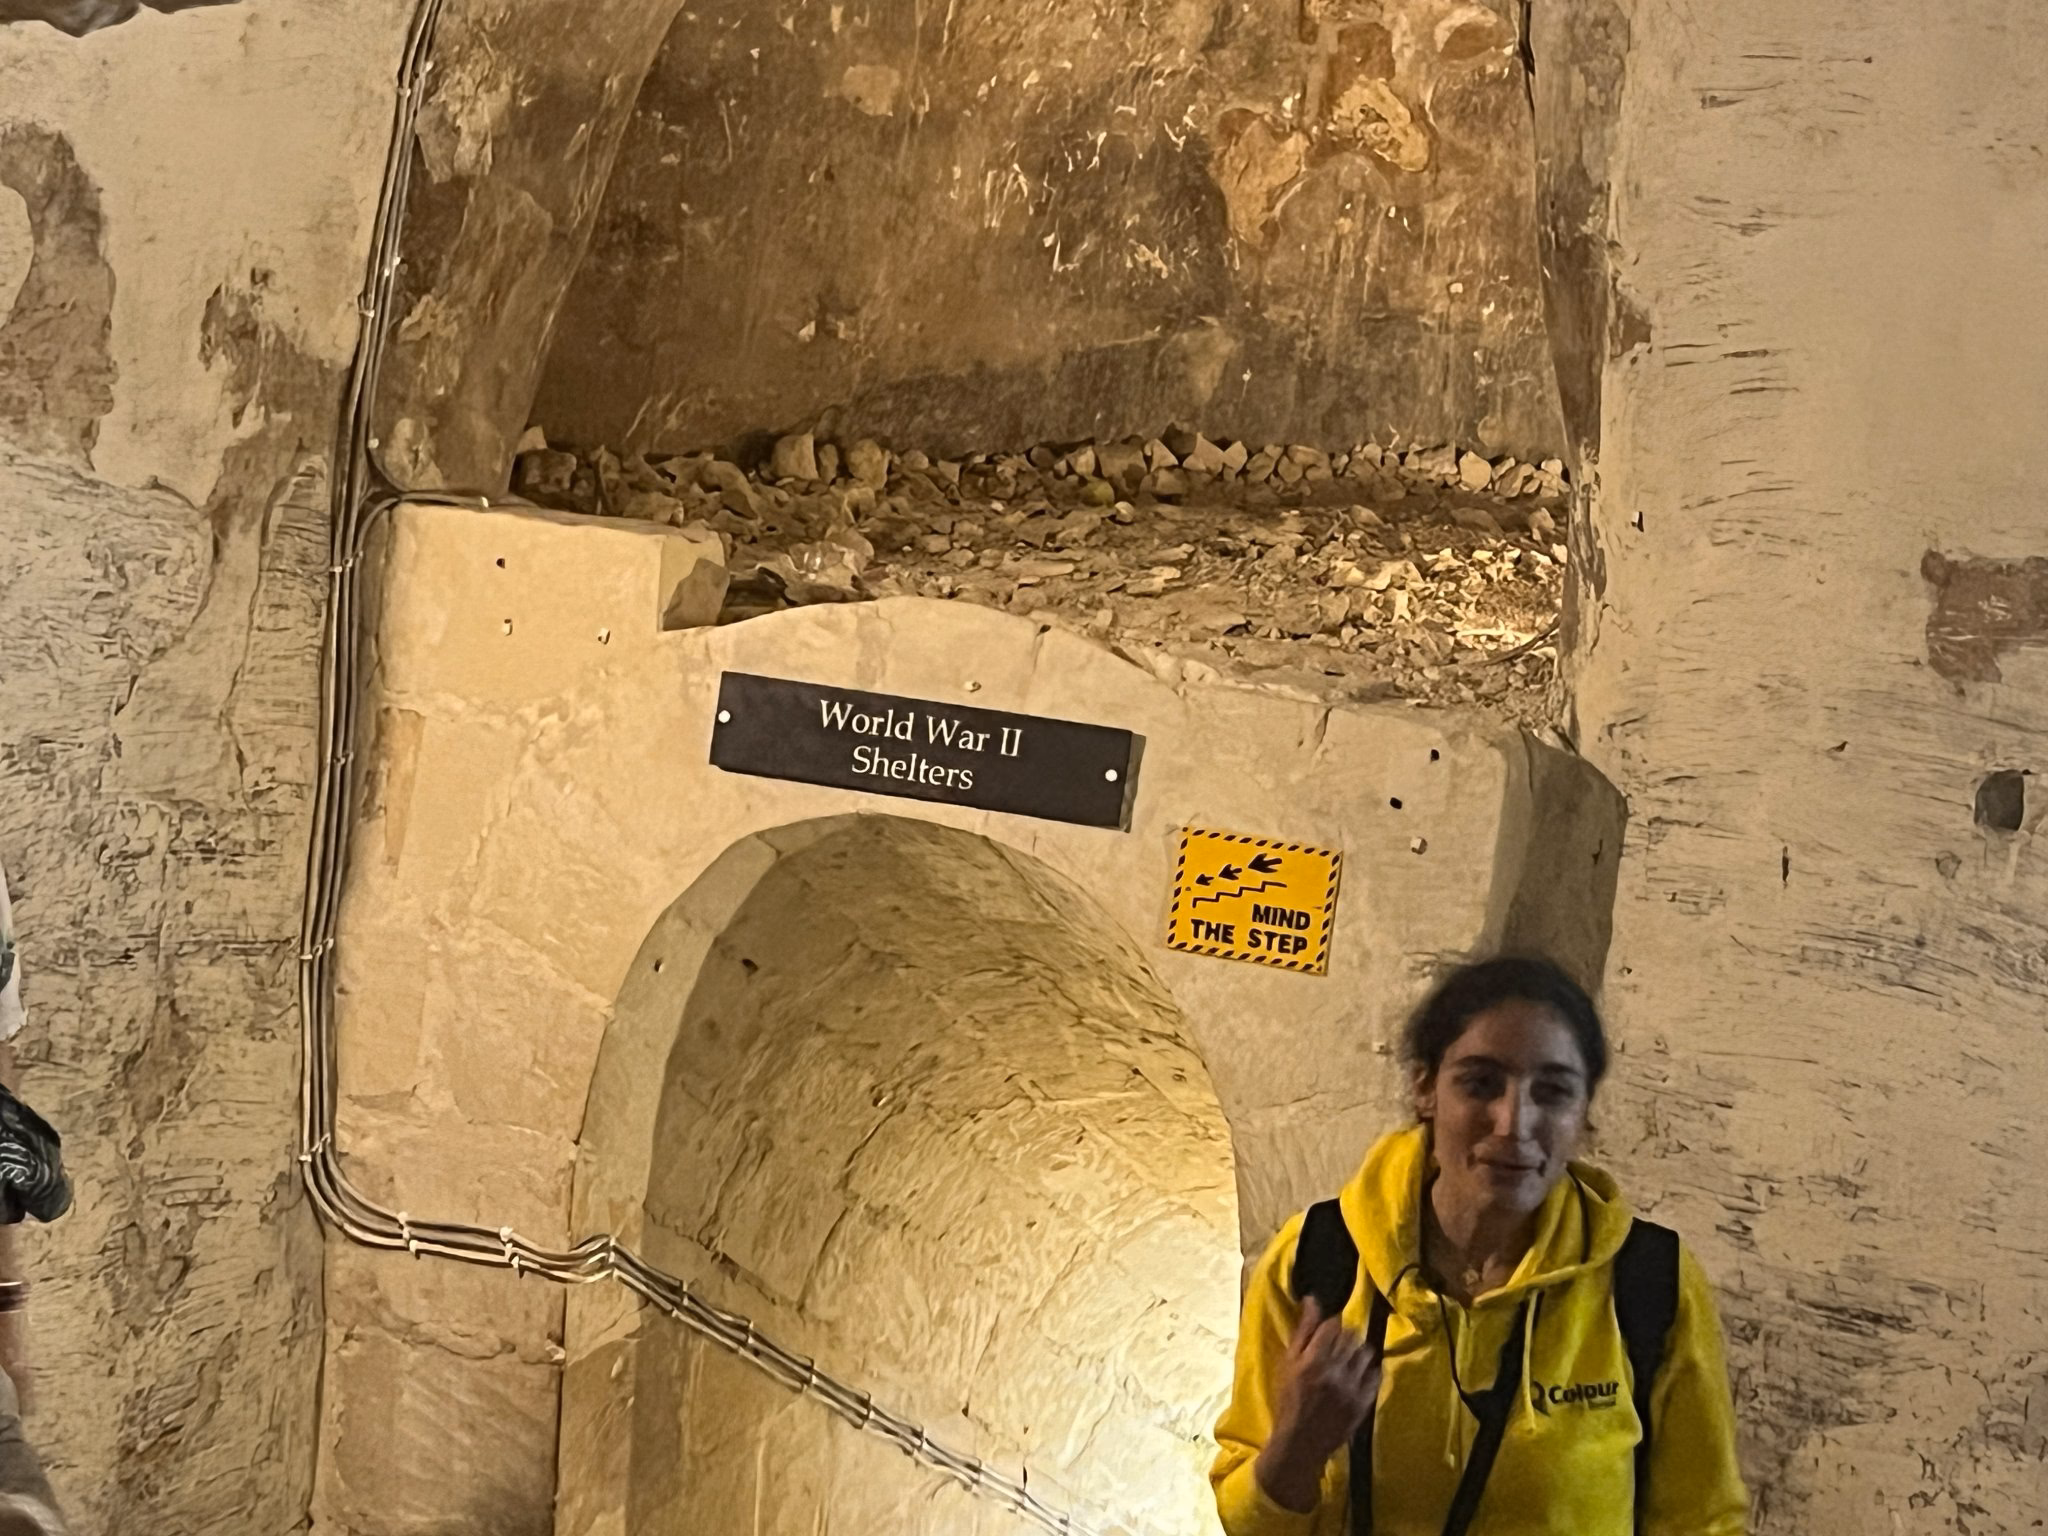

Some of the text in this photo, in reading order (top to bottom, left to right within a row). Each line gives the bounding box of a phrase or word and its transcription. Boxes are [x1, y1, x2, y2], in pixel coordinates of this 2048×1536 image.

[819, 698, 1024, 758] World War II
[850, 745, 975, 790] Shelters
[1251, 903, 1311, 930] MIND
[1190, 918, 1308, 955] THE STEP
[1548, 1379, 1620, 1405] Colour
